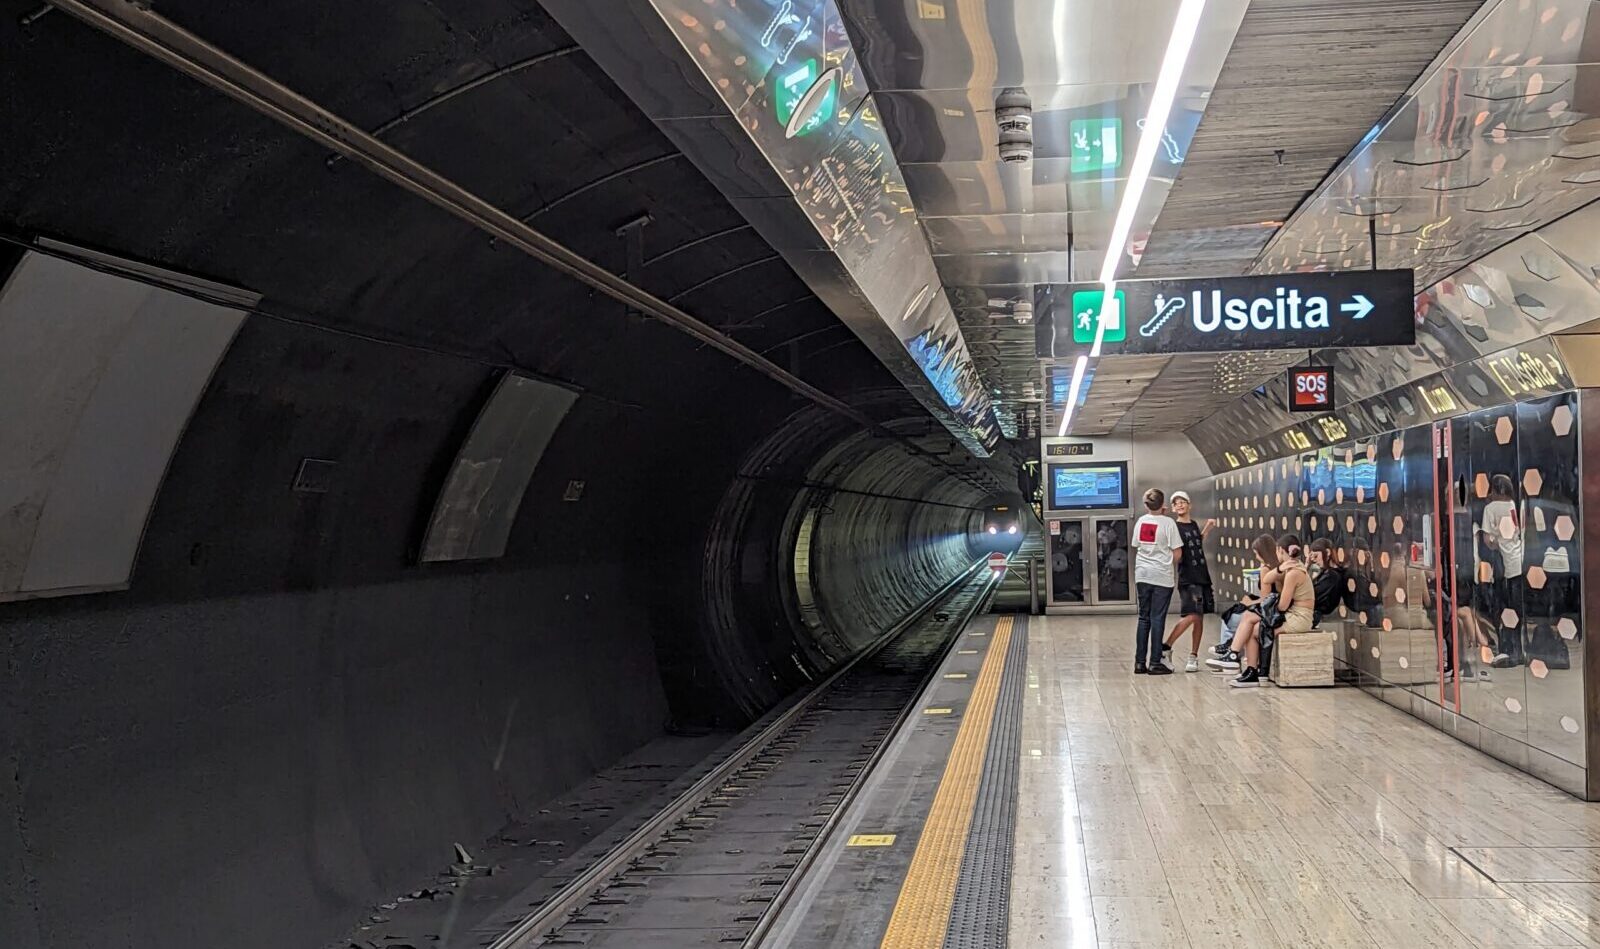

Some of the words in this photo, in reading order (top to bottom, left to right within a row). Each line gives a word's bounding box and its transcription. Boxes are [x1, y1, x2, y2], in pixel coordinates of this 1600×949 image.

[1192, 287, 1330, 332] Uscita
[1296, 374, 1327, 393] SOS
[1500, 352, 1558, 391] Uscita
[1053, 445, 1078, 455] 16:10
